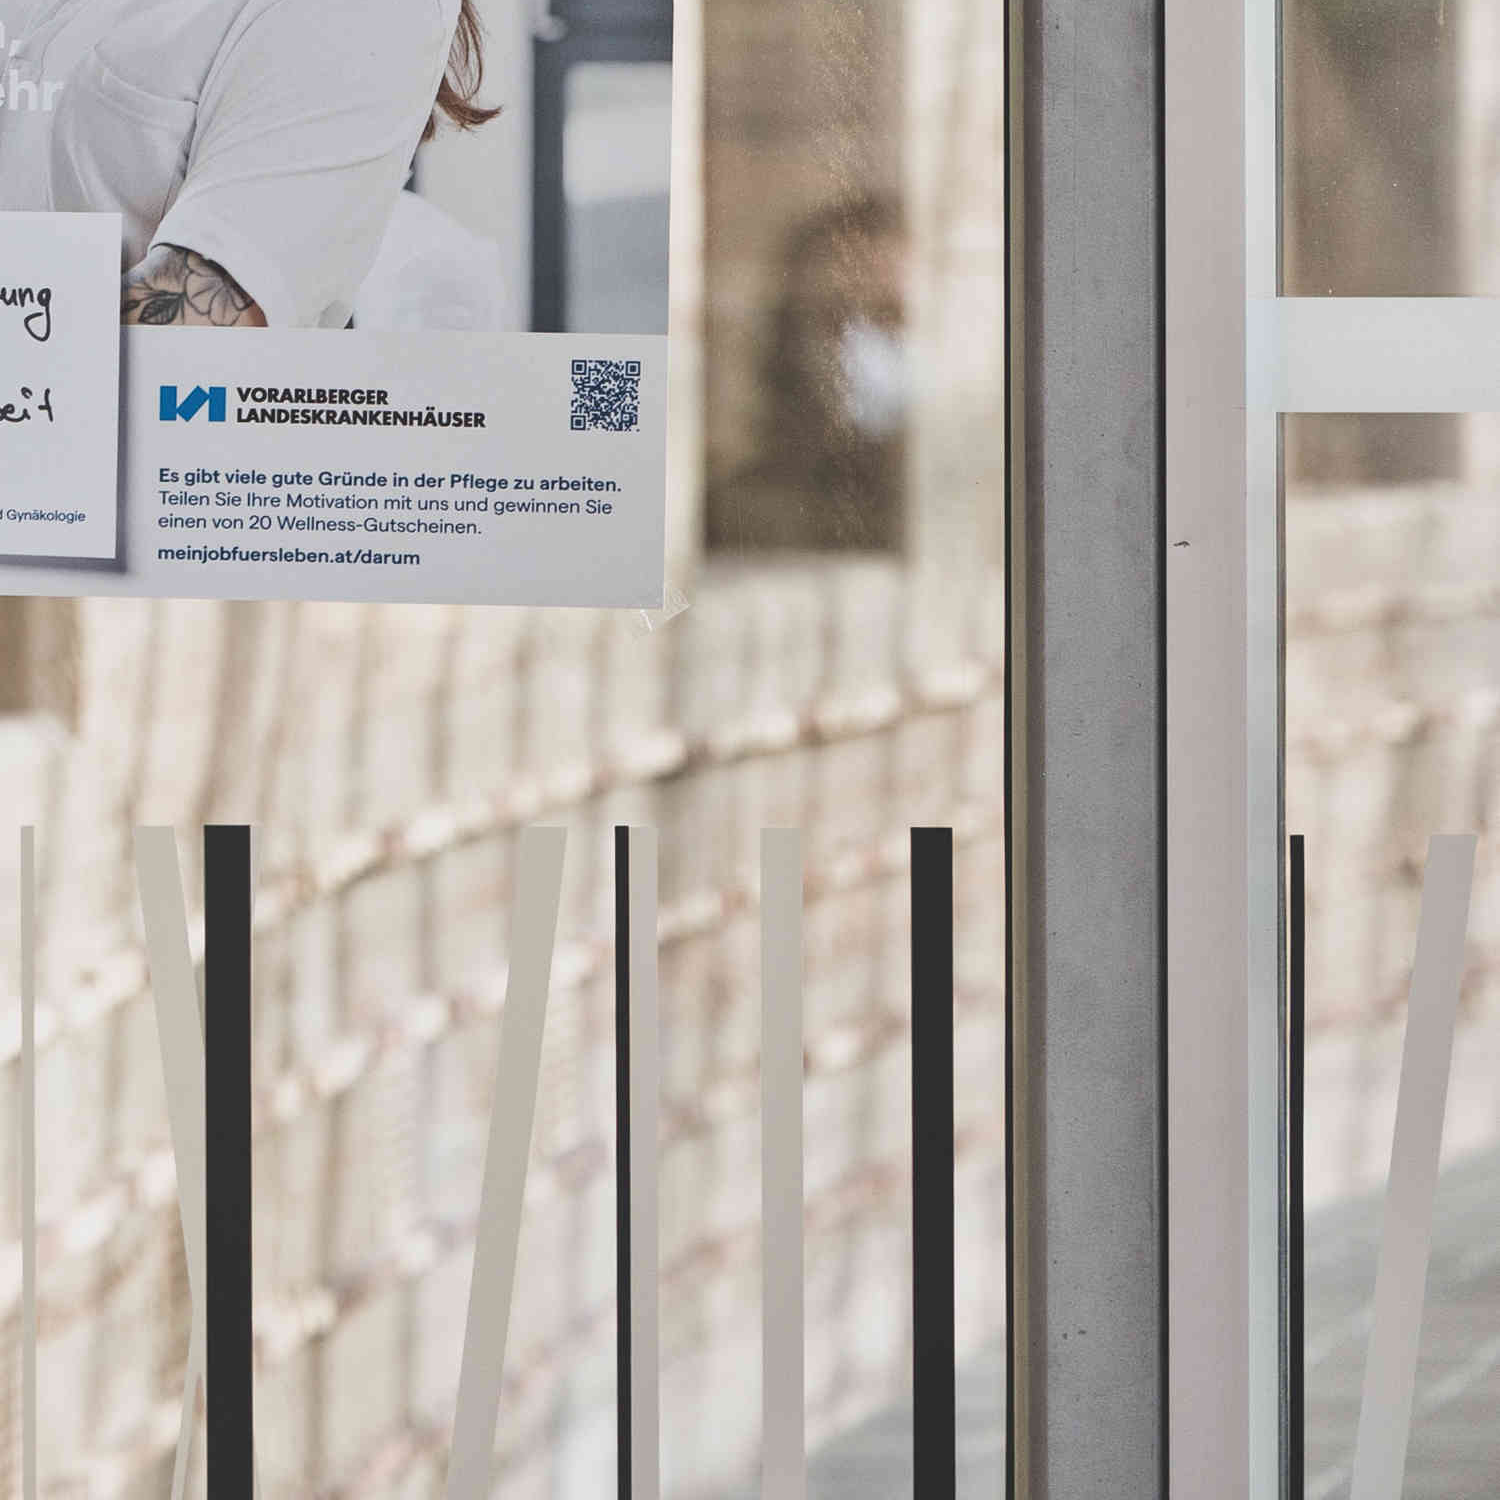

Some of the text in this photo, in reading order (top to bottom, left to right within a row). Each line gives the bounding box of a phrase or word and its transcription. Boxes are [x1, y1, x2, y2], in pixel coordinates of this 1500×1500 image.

[236, 387, 389, 405] VORARLBERGER
[236, 406, 486, 428] LANDESKRANKENHÄUSER
[159, 468, 622, 493] Es gibt viele gute Gründe in der Pflege zu arbeiten.
[159, 490, 613, 515] Teilen Sie Ihre Motivation mit uns und gewinnen Sie
[6, 508, 87, 525] Gynäkologie
[158, 514, 482, 535] einen von 20 Wellness-Gutscheinen.
[158, 545, 420, 565] meinjobfuersleben.at/darum
